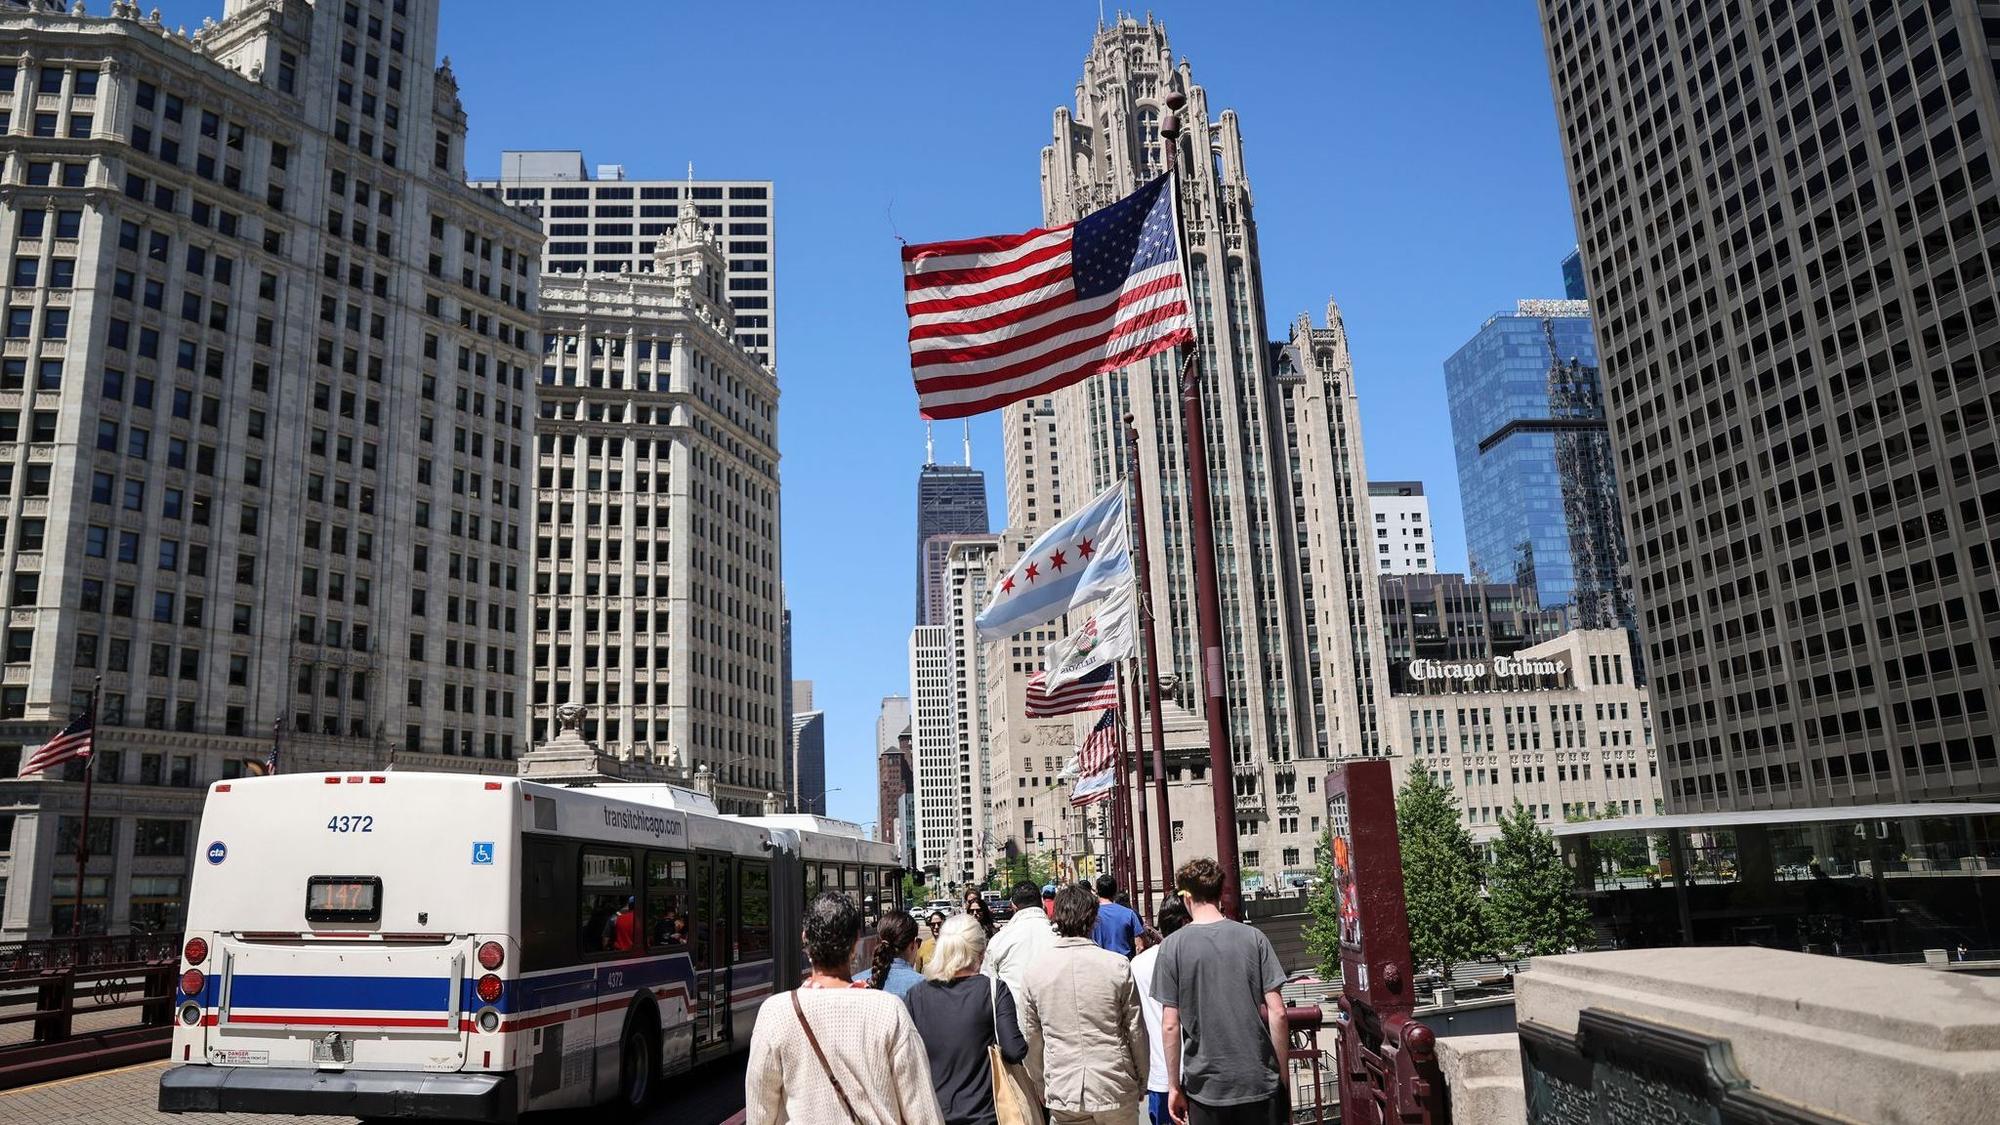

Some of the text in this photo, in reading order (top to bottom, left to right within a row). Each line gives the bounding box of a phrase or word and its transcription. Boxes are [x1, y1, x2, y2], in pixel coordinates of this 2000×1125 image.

[1409, 655, 1567, 681] Chicago Tribune
[327, 815, 374, 833] 4372
[604, 805, 682, 838] transitchicago.com
[210, 849, 225, 857] cta
[325, 884, 363, 911] 147
[608, 971, 624, 988] 4372
